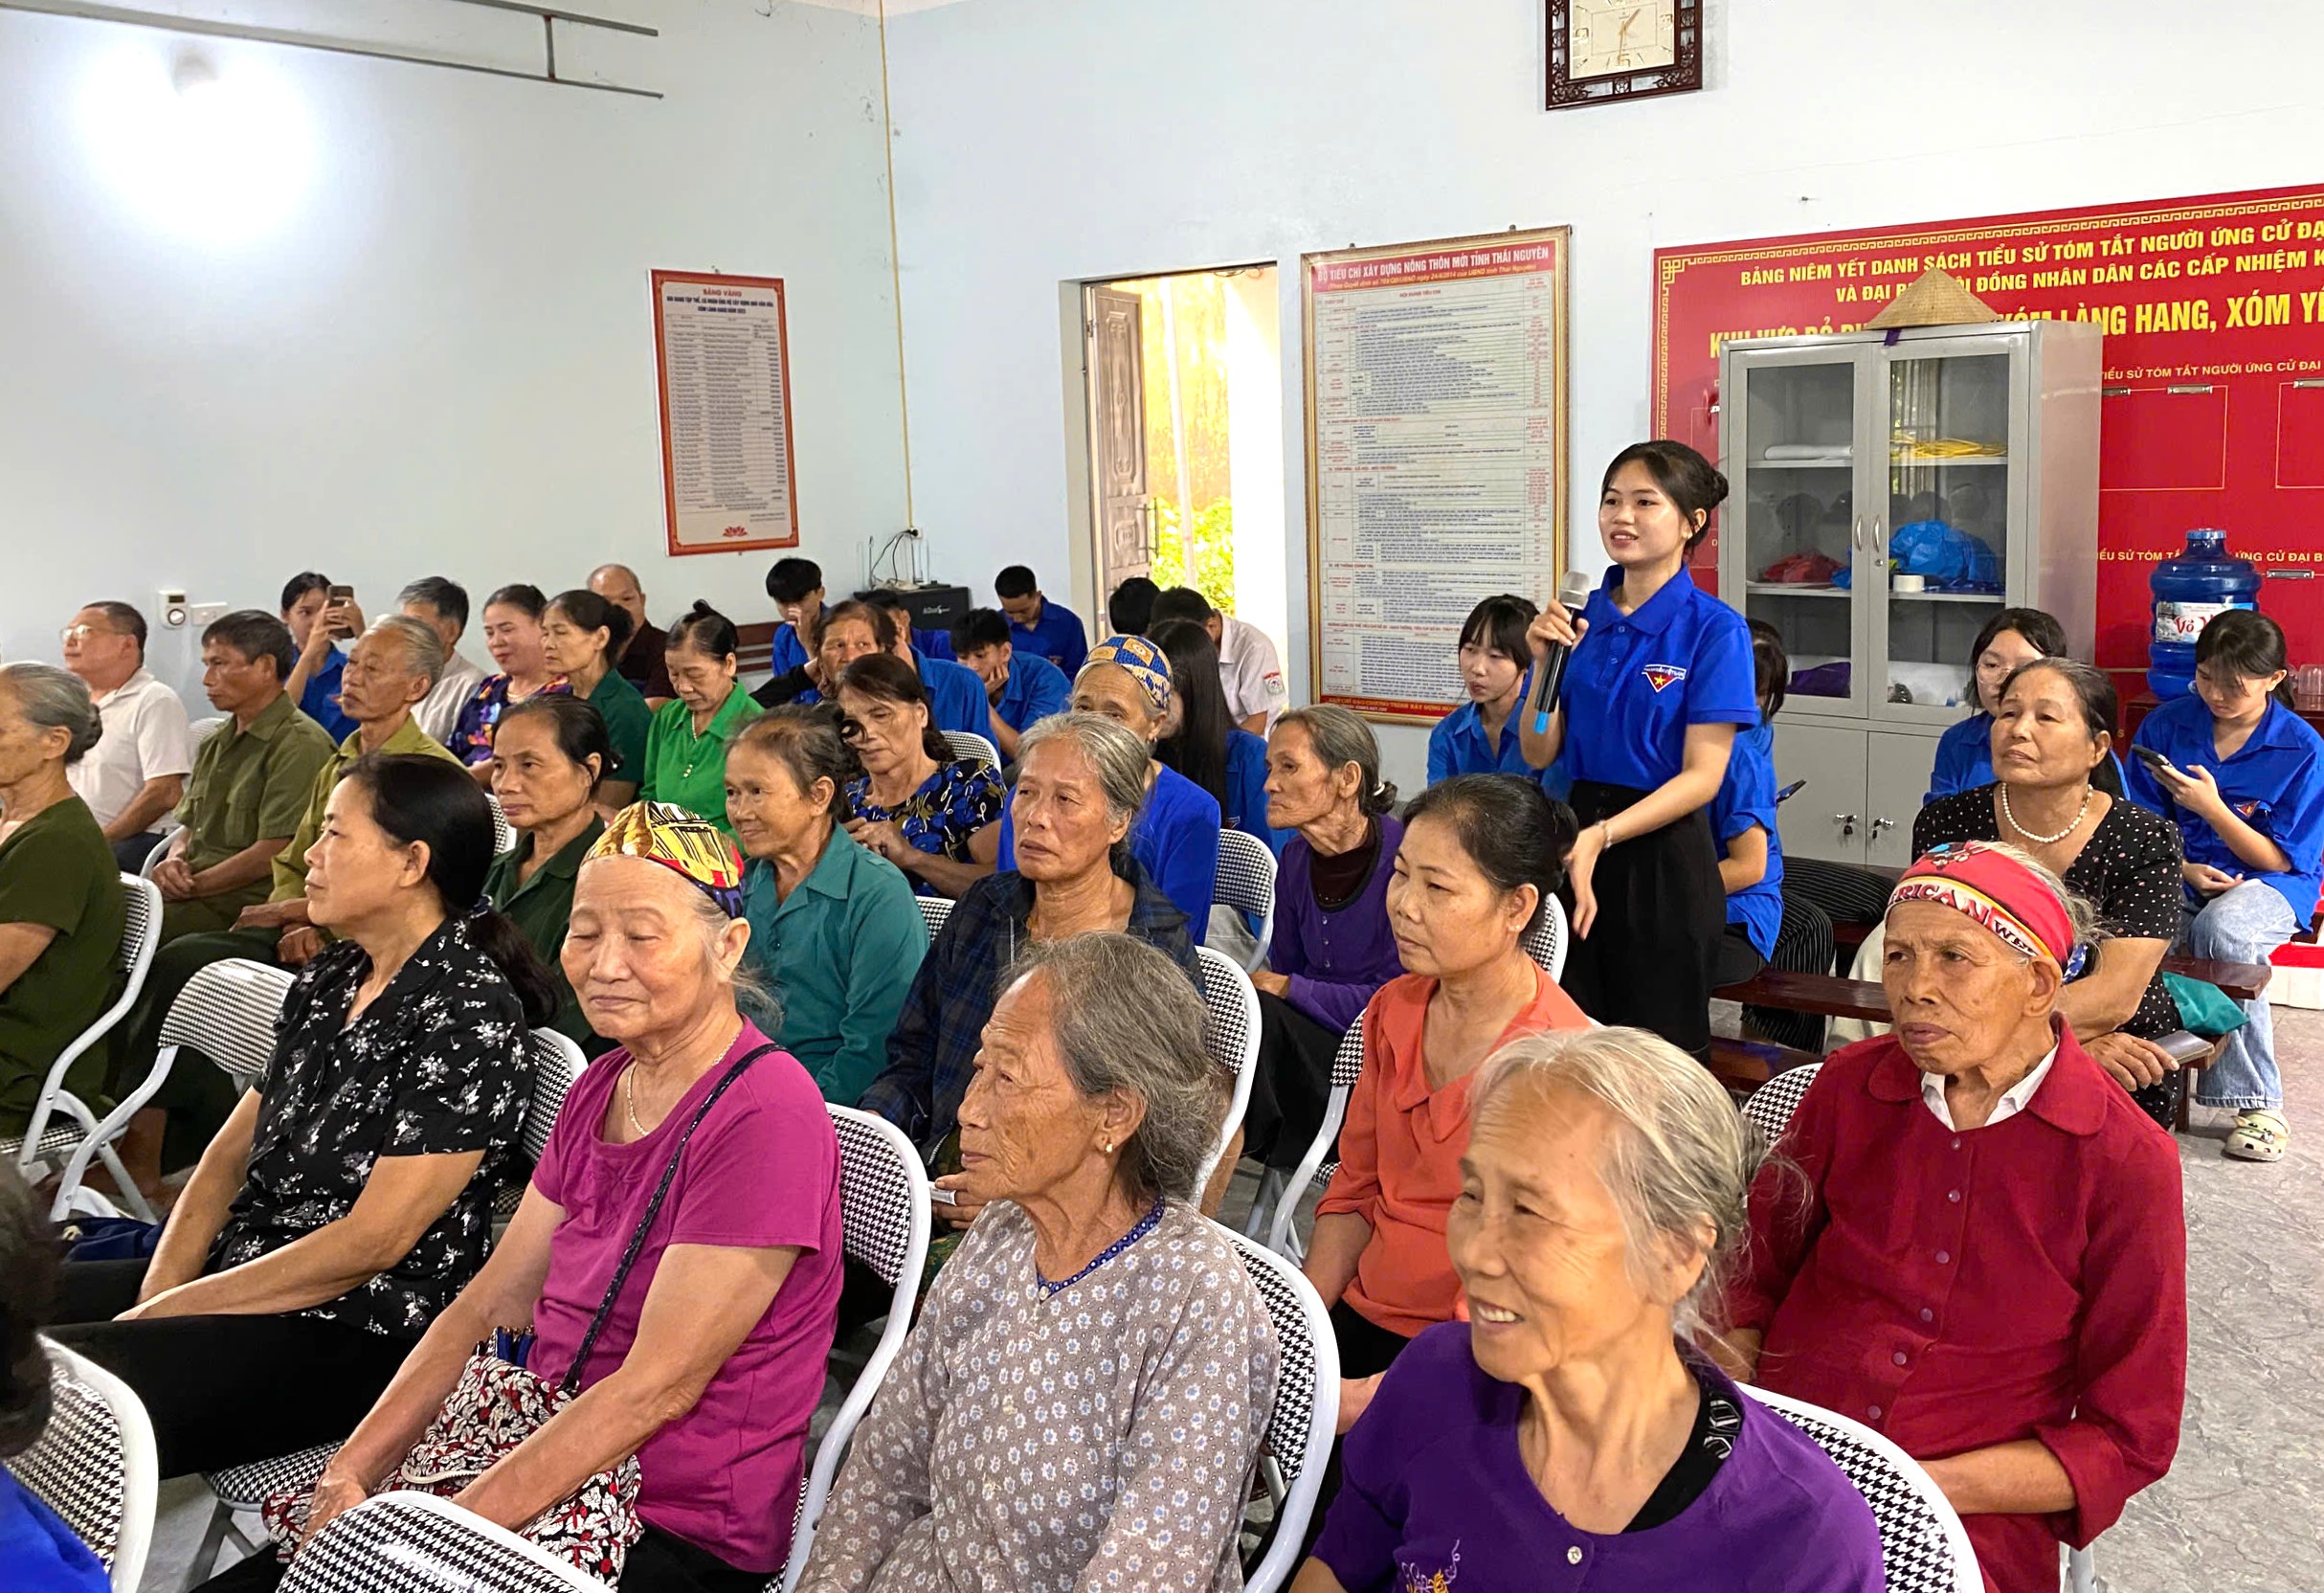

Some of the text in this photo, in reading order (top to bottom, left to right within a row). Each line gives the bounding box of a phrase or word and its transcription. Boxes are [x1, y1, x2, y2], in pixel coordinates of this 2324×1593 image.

[1330, 266, 1347, 280] TIÊU
[1349, 263, 1362, 279] CHÍ
[1363, 263, 1378, 278] XÂY
[1380, 262, 1402, 278] DỰNG
[1404, 258, 1426, 274] NÔNG
[1429, 256, 1450, 270] THÔN
[1452, 253, 1468, 268] MỚI
[1470, 251, 1490, 266] TỈNH
[1492, 249, 1511, 264] THÁI
[1513, 245, 1549, 262] NGUYÊN
[1740, 218, 2324, 286] BẢNG NIÊM YẾT DANH SÁCH TIỂU SỬ TÓM TẮT NGƯỜI ỨNG CỬ ĐẠ
[1976, 271, 2027, 292] ĐỒNG
[2033, 267, 2087, 288] NHÂN
[2092, 264, 2134, 284] DÂN
[2139, 259, 2180, 280] CÁC
[2187, 252, 2229, 277] CẤP
[2235, 249, 2307, 273] NHIỆM
[1836, 283, 1858, 303] VÀ
[1862, 282, 1891, 303] ĐẠI
[2135, 299, 2217, 333] HANG,
[2225, 289, 2290, 328] XÓM
[2102, 358, 2321, 380] IỂU SỬ TÓM TẮT NGƯỜI ỨNG CỬ ĐẠI
[2117, 548, 2135, 561] SỬ
[2136, 550, 2163, 561] TÓM
[2266, 549, 2286, 562] CỬ
[2288, 552, 2311, 564] ĐẠI
